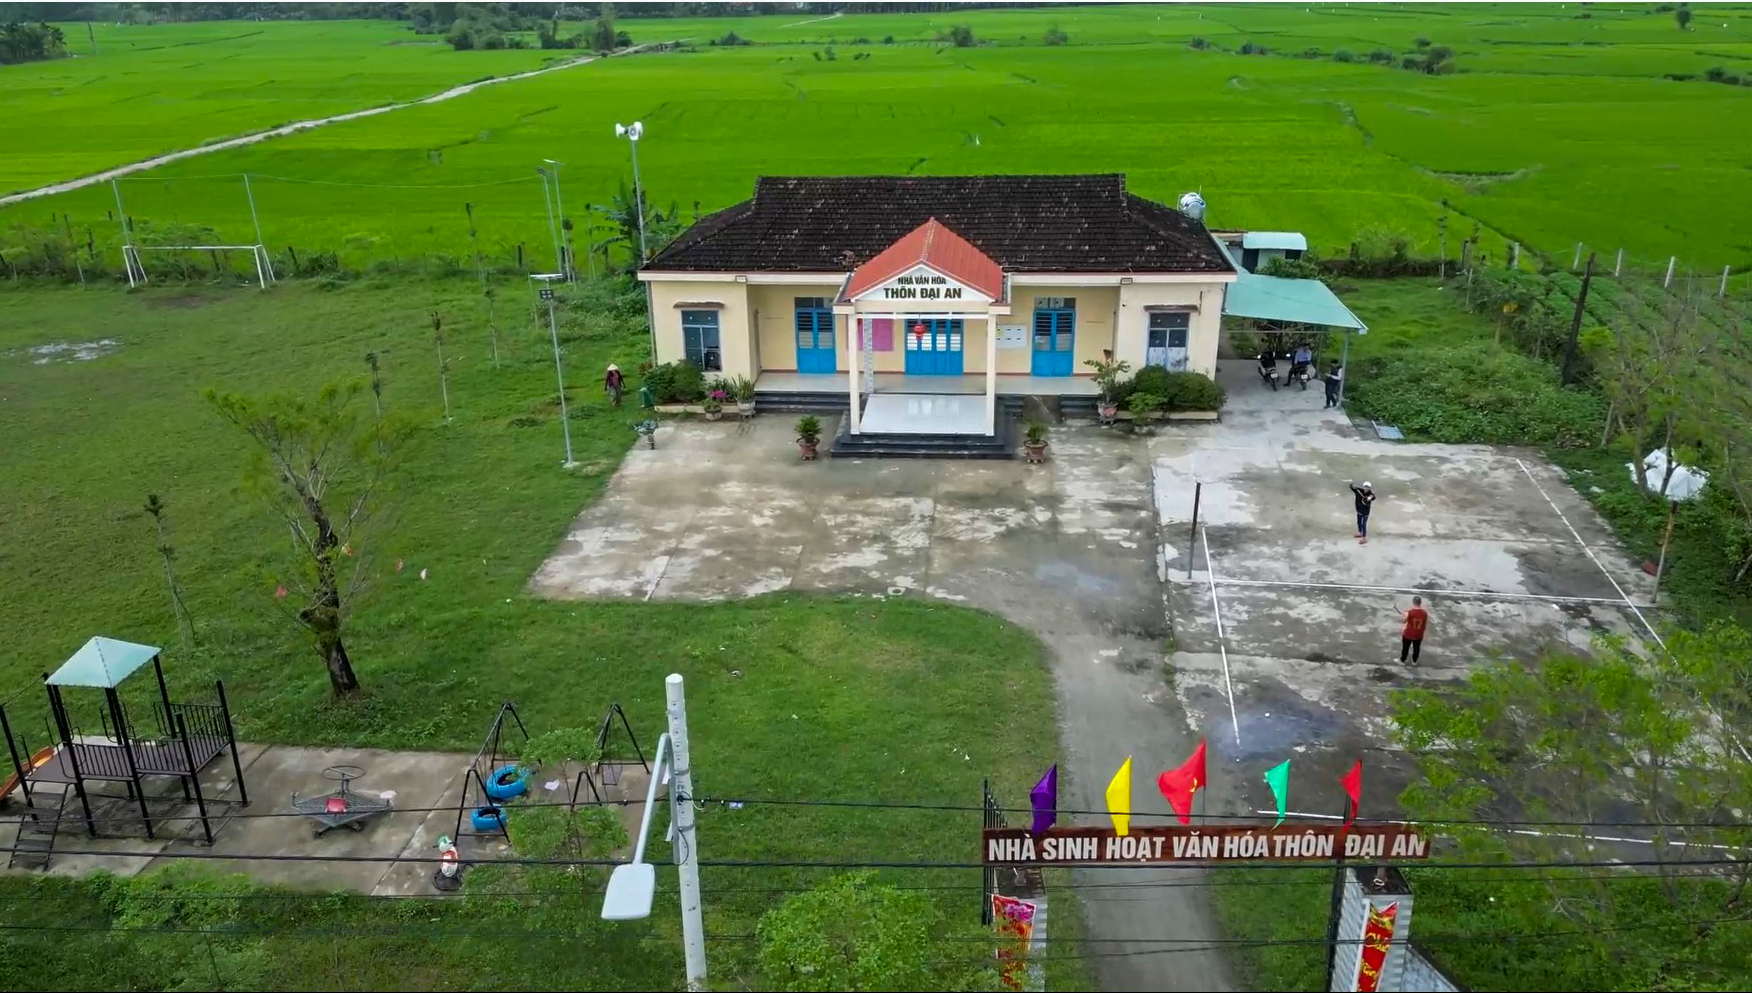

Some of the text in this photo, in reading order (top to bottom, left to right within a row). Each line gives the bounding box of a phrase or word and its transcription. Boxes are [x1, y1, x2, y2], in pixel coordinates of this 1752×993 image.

[897, 275, 914, 285] NHÀ
[883, 285, 962, 300] THÔN ĐẠI AN
[1412, 617, 1422, 630] 17
[988, 829, 1424, 862] NHÀ SINH HOẠT VĂN HÓA THÔN ĐẠI AN
